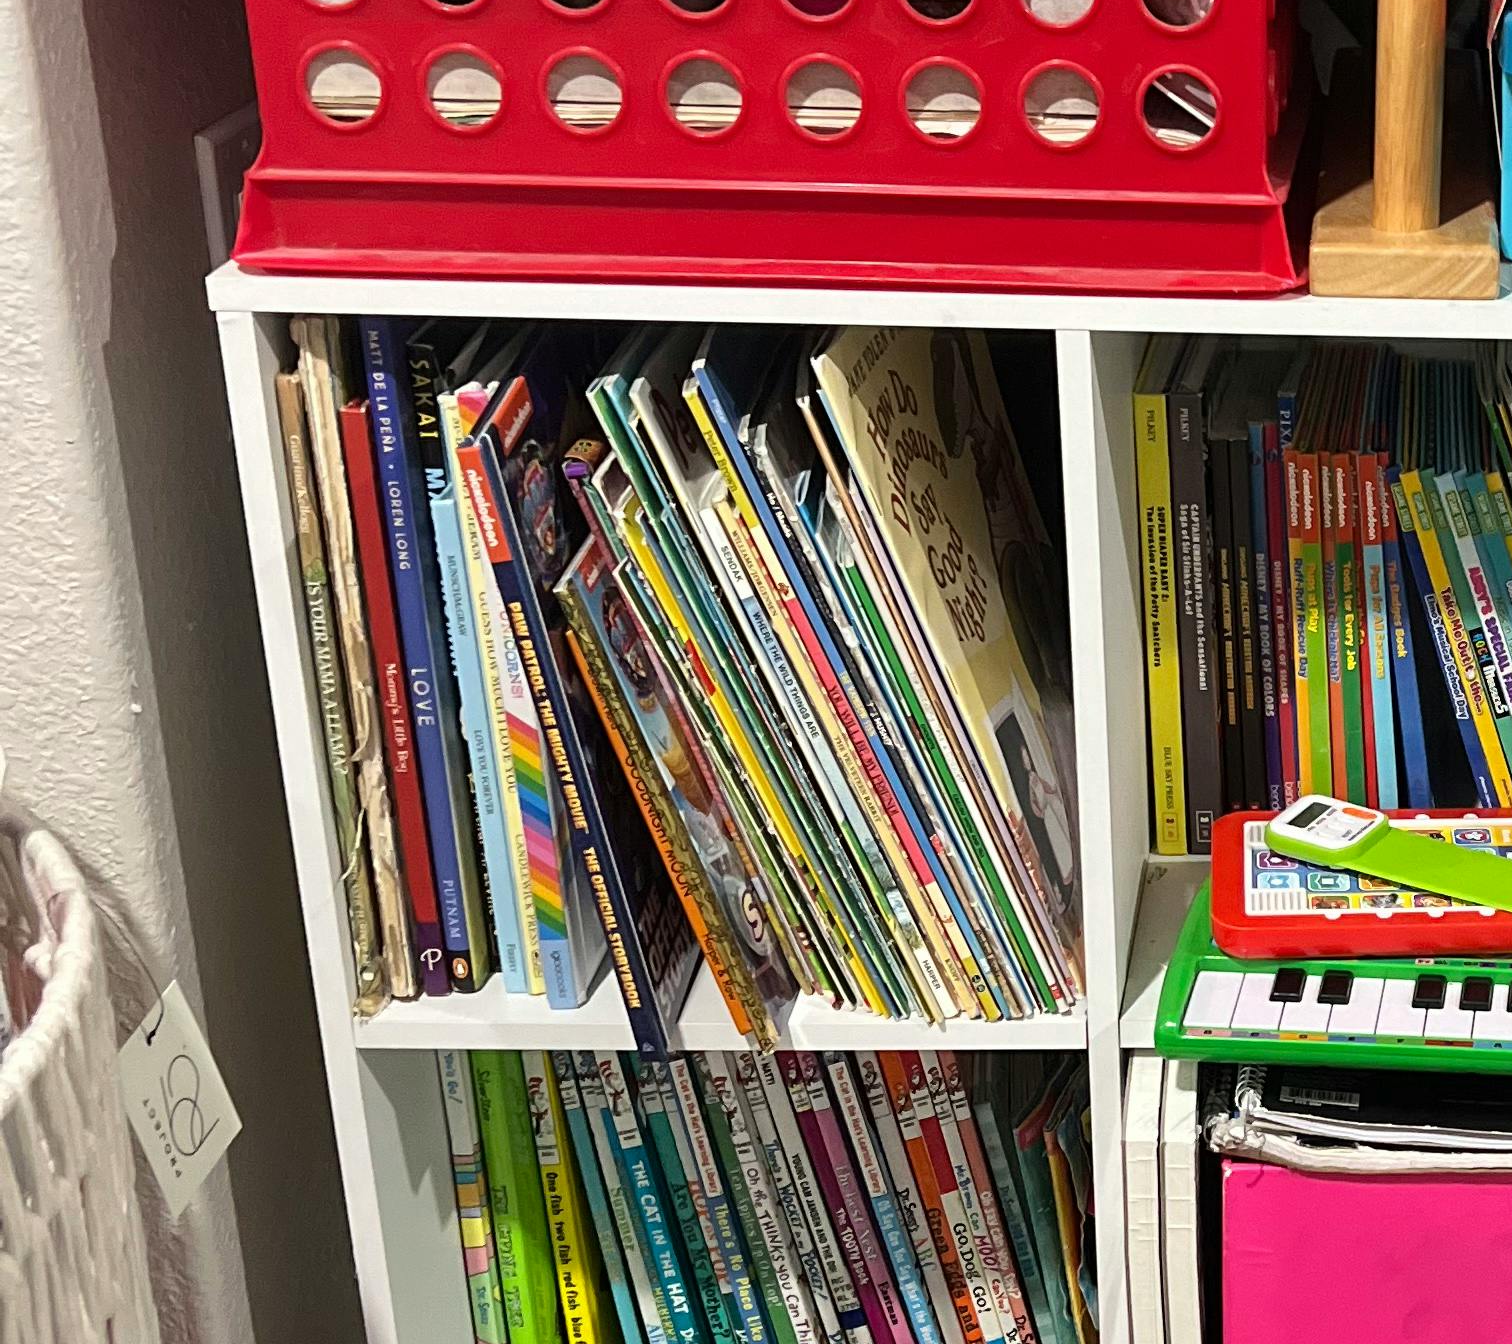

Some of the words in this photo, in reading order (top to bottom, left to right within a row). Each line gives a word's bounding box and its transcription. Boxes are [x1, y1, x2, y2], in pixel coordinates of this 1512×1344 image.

[867, 395, 900, 464] How
[888, 369, 918, 416] Do
[887, 426, 949, 537] Dinosaurs
[463, 466, 502, 548] nickelodeon
[910, 483, 943, 534] Say
[1365, 480, 1377, 540] nickelodeon
[718, 544, 744, 582] SENDAK
[927, 515, 964, 590] Good
[305, 579, 321, 595] IS
[945, 553, 988, 643] Night?
[307, 597, 328, 642] YOUR
[507, 600, 530, 638] PAW
[1466, 565, 1494, 616] ABBY'S
[1483, 616, 1512, 672] SPECIAL
[314, 644, 336, 695] MAMA
[751, 611, 774, 645] WHERE
[767, 644, 783, 664] THE
[776, 662, 795, 687] WILD
[788, 686, 811, 720] THINGS
[804, 719, 821, 739] ARE
[322, 697, 338, 710] A
[409, 666, 435, 727] LOVE
[537, 699, 556, 727] THE
[324, 712, 349, 776] LLAMA?
[545, 727, 574, 784] MIGHTY
[562, 783, 588, 830] MOVIE
[581, 846, 601, 874] THE
[442, 878, 461, 939] PUTNAM
[589, 873, 619, 931] OFFICIAL
[605, 931, 642, 1010] STORYBOOK
[545, 1171, 559, 1192] One
[629, 1159, 650, 1189] THE
[745, 1166, 762, 1186] Oh
[548, 1193, 563, 1216] fish
[639, 1192, 662, 1226] CAT
[750, 1188, 769, 1208] the
[553, 1220, 566, 1241] two
[651, 1227, 667, 1247] IN
[756, 1208, 787, 1262] THINKS
[557, 1243, 573, 1265] fish
[657, 1250, 677, 1278] THE
[561, 1270, 576, 1289] red
[666, 1281, 689, 1316] HAT
[565, 1289, 580, 1311] fish
[784, 1292, 804, 1318] Can
[569, 1315, 585, 1338] blue
